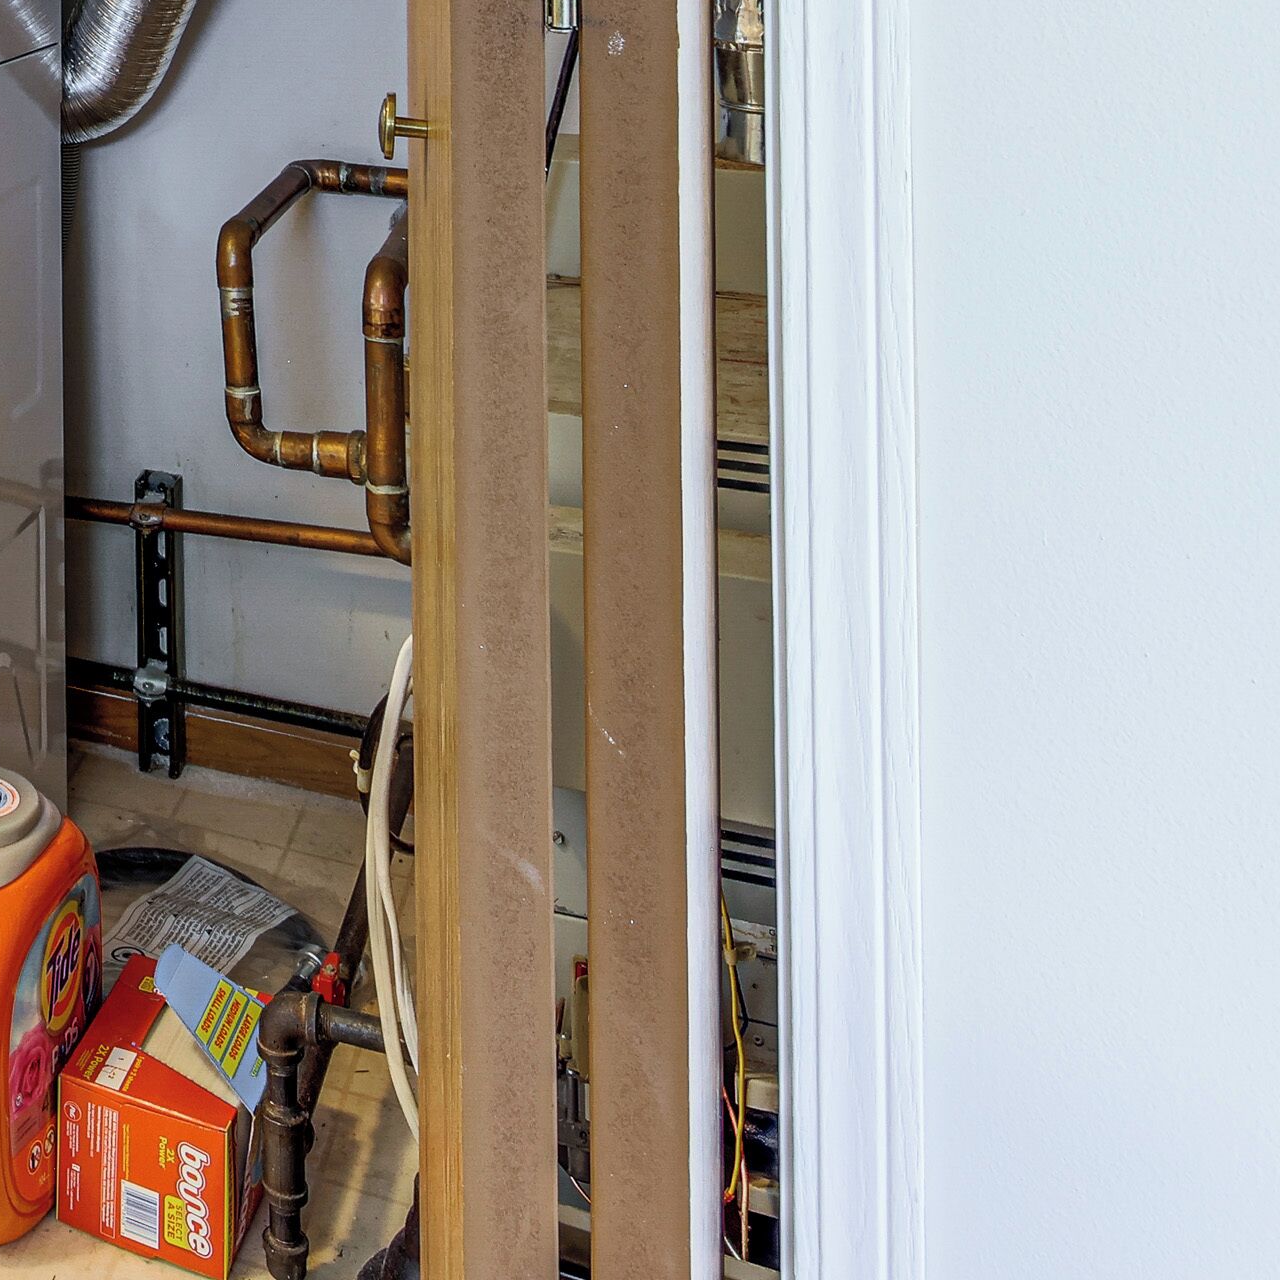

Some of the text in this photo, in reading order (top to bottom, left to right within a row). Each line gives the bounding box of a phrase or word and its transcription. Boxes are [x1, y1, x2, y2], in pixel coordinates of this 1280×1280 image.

[46, 918, 81, 1029] Tide
[200, 987, 227, 1034] SMALL LOADS
[215, 999, 241, 1049] MEDIUM LOADS
[228, 1014, 253, 1061] LARGE LOADS
[83, 1044, 110, 1080] 2X Power
[158, 1136, 168, 1169] Power
[166, 1147, 176, 1164] 2X
[167, 1202, 176, 1240] A SIZE
[178, 1142, 212, 1258] bounce
[175, 1205, 184, 1241] SELECT
